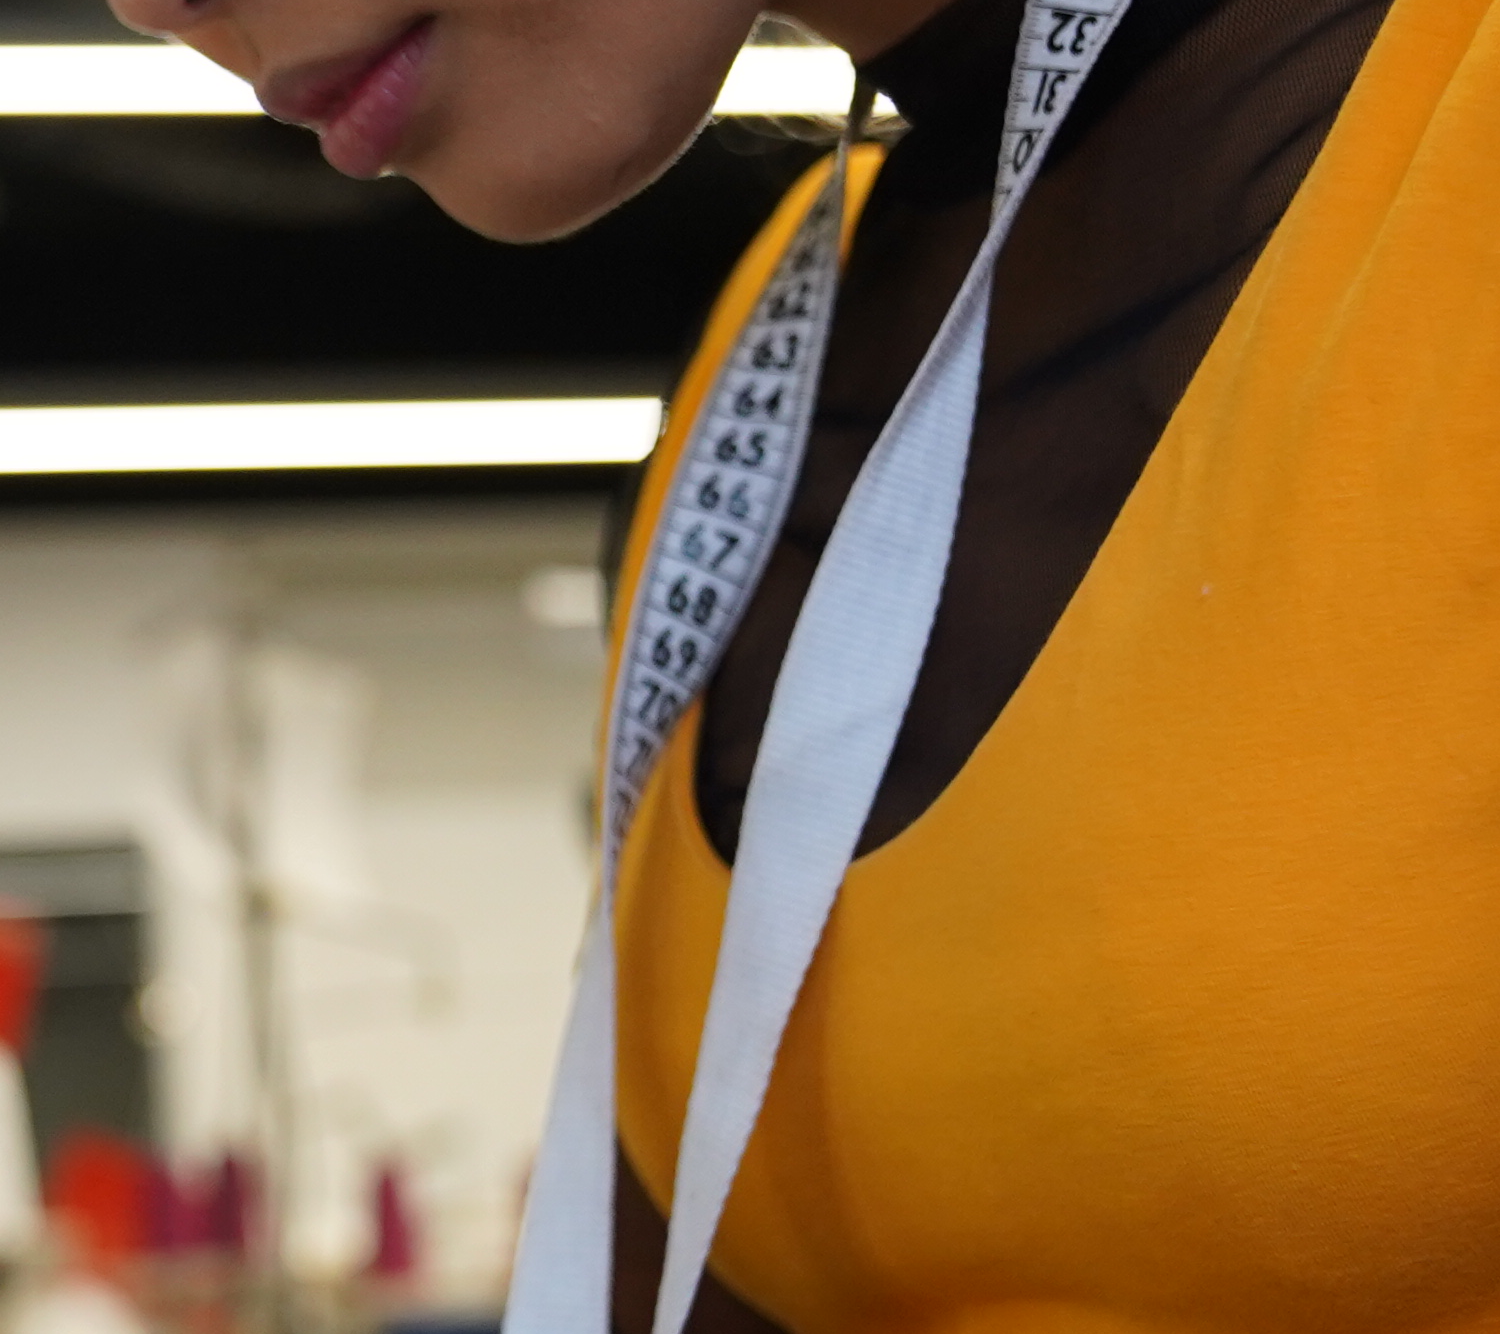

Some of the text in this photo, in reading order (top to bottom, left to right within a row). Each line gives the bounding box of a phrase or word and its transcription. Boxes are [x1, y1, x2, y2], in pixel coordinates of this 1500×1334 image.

[1046, 10, 1098, 55] 32
[1031, 72, 1067, 115] 31
[753, 332, 799, 371] 63
[733, 383, 783, 418] 64
[715, 428, 768, 468] 65
[697, 474, 750, 518] 66
[681, 523, 740, 571] 67
[668, 574, 718, 626] 68
[652, 628, 697, 678] 69
[638, 678, 678, 732] 70
